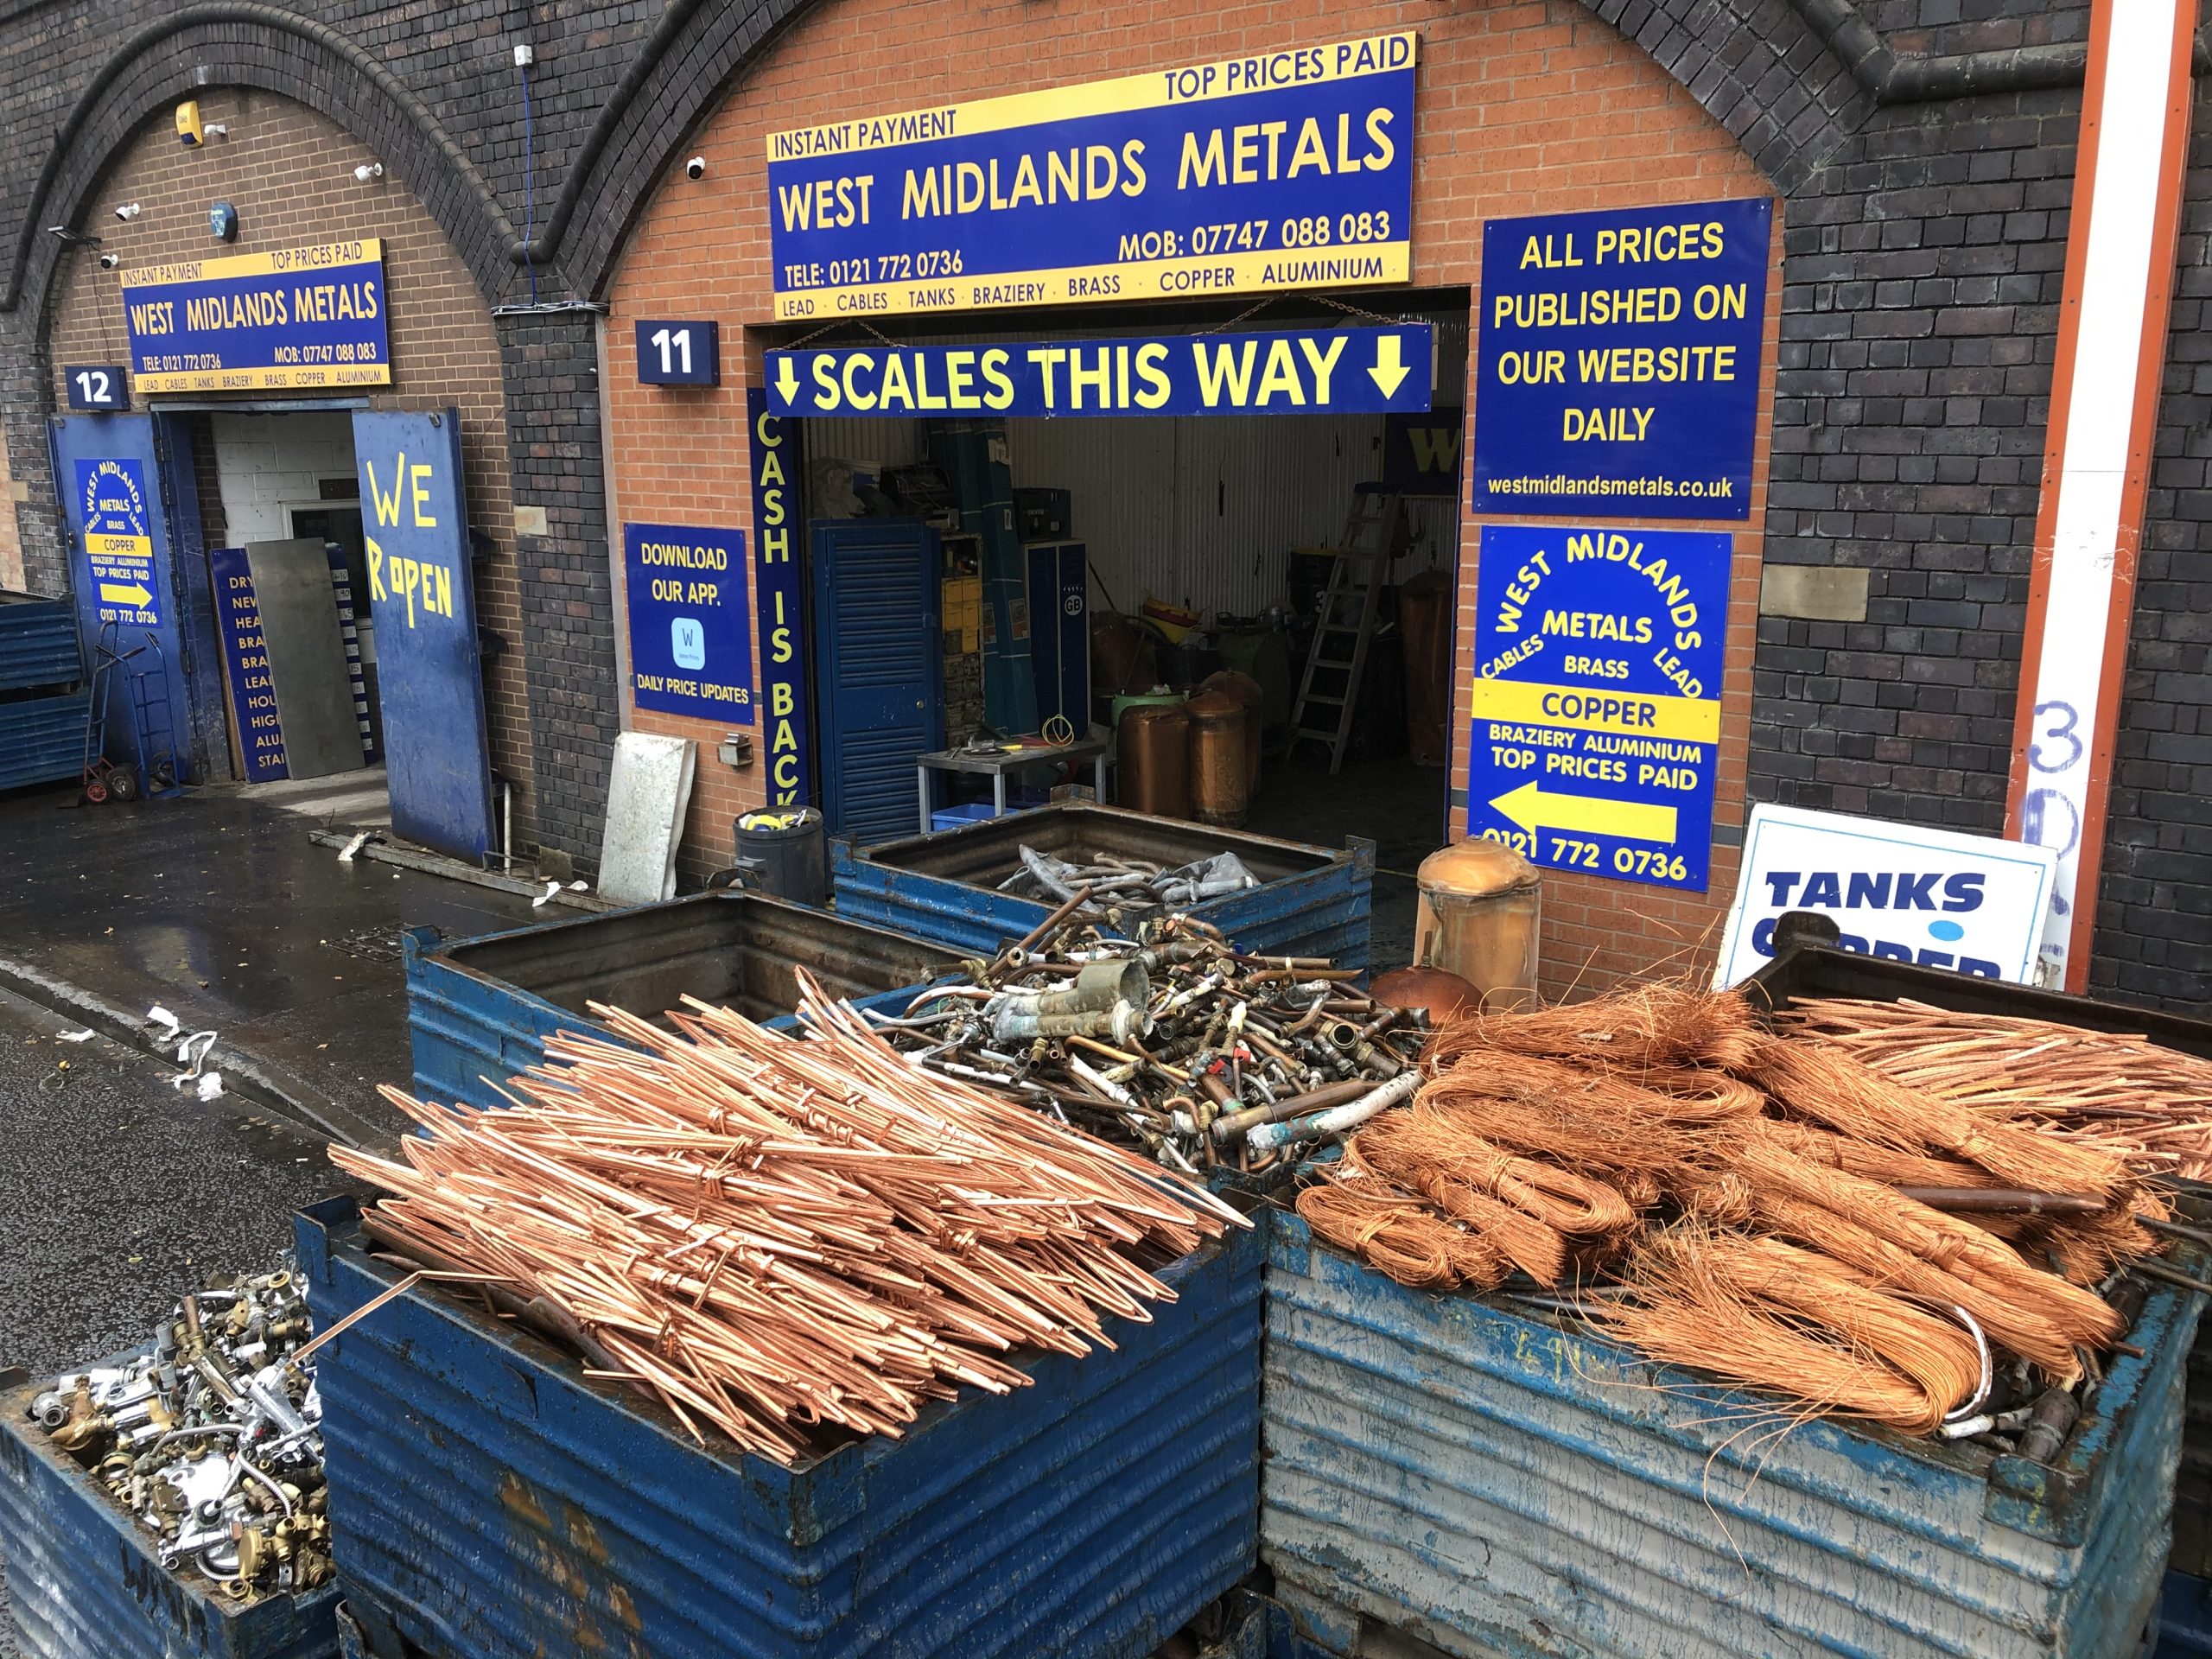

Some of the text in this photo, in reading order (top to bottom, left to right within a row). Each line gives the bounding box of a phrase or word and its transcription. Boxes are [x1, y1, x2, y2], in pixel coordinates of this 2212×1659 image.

[1165, 36, 1409, 100] TOP PRICES PAID
[774, 110, 957, 157] INSTANT PAYMENT
[779, 106, 1395, 232] WEST MIDLANDS METALS
[1118, 210, 1390, 262] MOB: 07747 088 083
[1520, 222, 1724, 270] ALL PRICES
[270, 242, 363, 270] TOP PRICES PAID
[785, 249, 963, 289] TELE: 0121 772 0736
[123, 263, 202, 286] INSTANT PAYMENT
[783, 257, 1383, 317] LEAD CABLES TANKS BRAZIERY BRASS COPPER ALUMINIUM
[130, 281, 378, 336] WEST MIDLANDS METALS
[1494, 283, 1747, 329] PUBLISHED ON
[143, 353, 221, 372] TELE: 0121 772 0736
[274, 341, 377, 363] MOB: 07747 088 083
[651, 329, 693, 374] 11
[1497, 346, 1737, 385] OUR WEBSITE
[75, 372, 111, 403] 12
[143, 370, 381, 391] LEAD CABLES TANKS BRAZIERY BRASS COPPER ALUMINIUM
[812, 335, 1348, 410] SCALES THIS WAY
[1563, 407, 1655, 442] DAILY
[86, 461, 143, 514] WEST MIDLANDS
[366, 451, 437, 527] WE
[757, 410, 789, 564] CASH
[1488, 474, 1732, 499] westmidlandsmetals.co.uk
[85, 512, 102, 534] CABLES
[99, 499, 130, 512] METALS
[106, 520, 125, 531] BRASS
[129, 512, 143, 536] LEAD
[104, 539, 135, 552] COPPER
[641, 543, 728, 571] DOWNLOAD
[92, 566, 149, 581] TOP PRICES PAID
[366, 536, 452, 629] R OPEN
[652, 579, 721, 606] OUR APP.
[1066, 598, 1081, 613] GB
[1496, 532, 1702, 651] WEST MIDLANDS
[100, 608, 157, 624] 0121 772 0736
[772, 591, 792, 664] IS
[1541, 609, 1653, 644] METALS
[238, 636, 265, 649] BRA
[682, 627, 693, 647] W
[241, 657, 269, 670] BRA
[1481, 633, 1544, 680] CABLES
[1564, 655, 1630, 680] BRASS
[1653, 647, 1703, 699] LEAD
[637, 673, 749, 704] DAILY PRICE UPDATES
[1541, 692, 1656, 728] COPPER
[256, 734, 283, 748] ALU
[1490, 724, 1702, 764] BRAZIERY ALUMINIUM
[1491, 747, 1698, 791] TOP PRICES PAID
[1551, 837, 1599, 868] 772
[1613, 847, 1688, 881] 0736
[1765, 871, 1986, 912] TANKS
